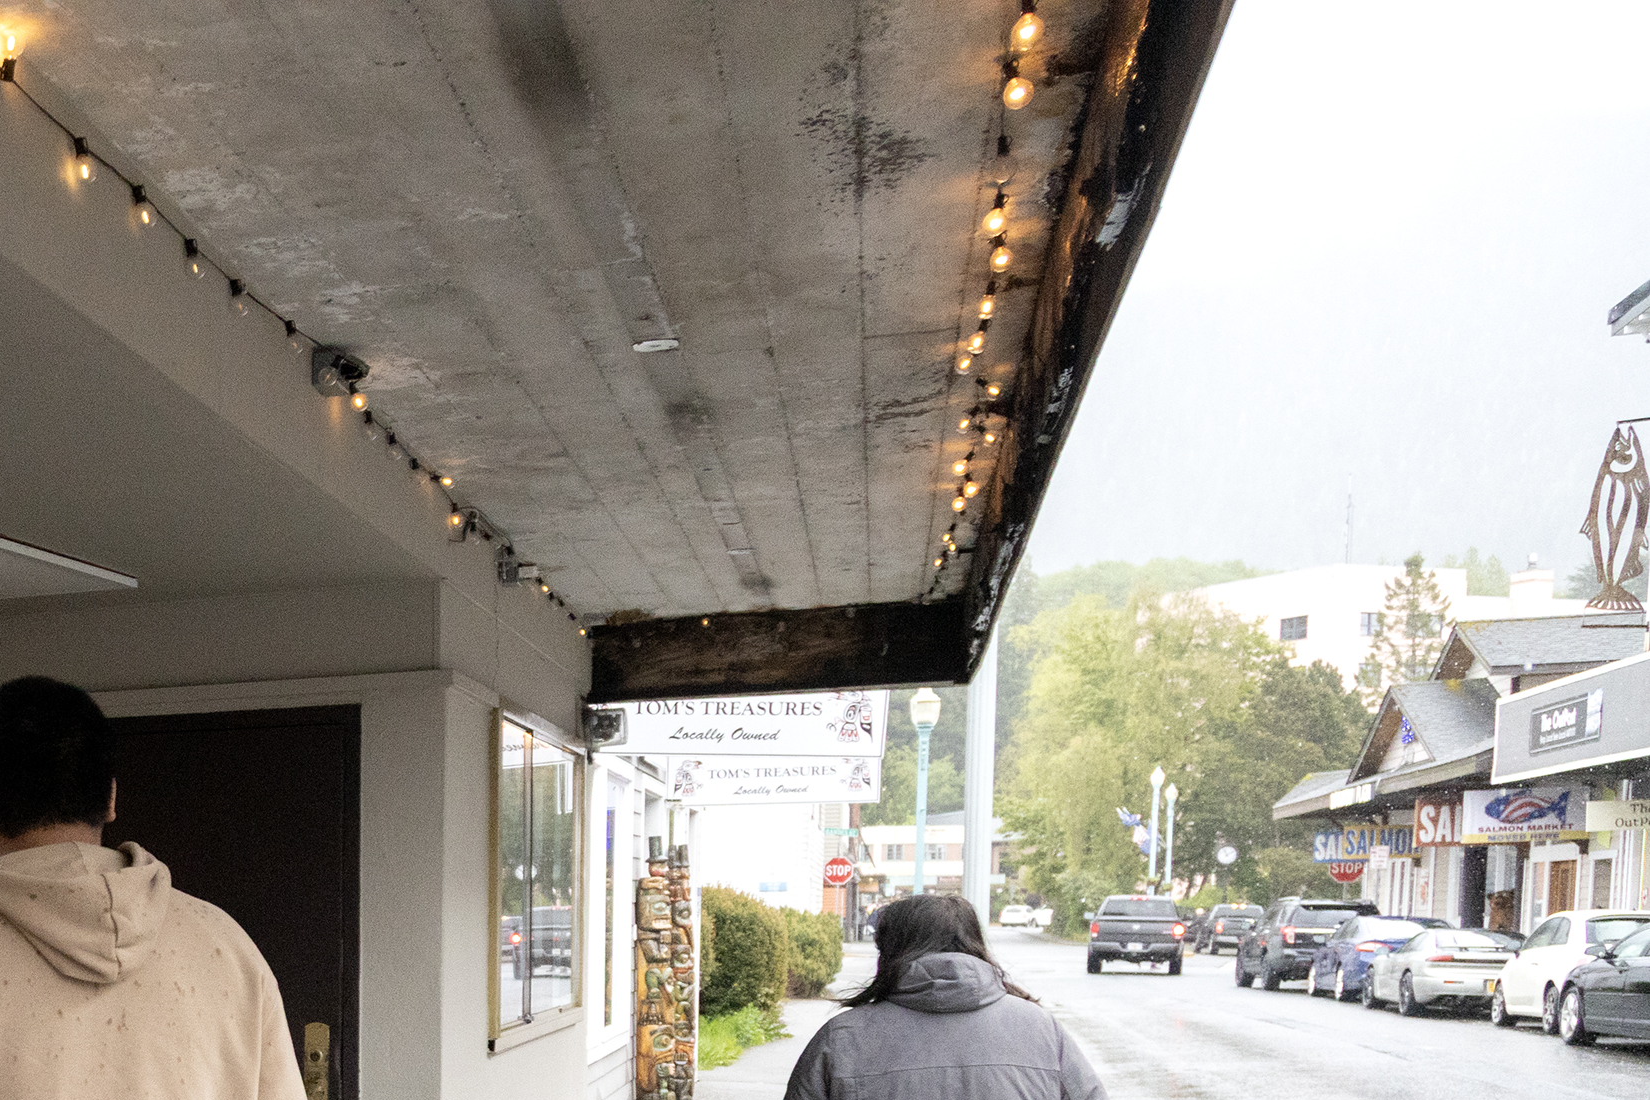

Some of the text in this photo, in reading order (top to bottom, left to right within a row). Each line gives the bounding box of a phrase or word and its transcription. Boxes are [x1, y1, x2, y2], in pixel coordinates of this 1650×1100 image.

[634, 700, 824, 717] TOM'S TREASURES
[668, 726, 782, 743] Locally Owned
[707, 765, 838, 780] TOM'S TREASURES
[733, 784, 810, 796] Locally Owned
[1478, 822, 1574, 834] SALMON MARKET
[1530, 832, 1560, 840] HERE
[826, 865, 852, 877] STOP
[1331, 862, 1364, 874] STOP
